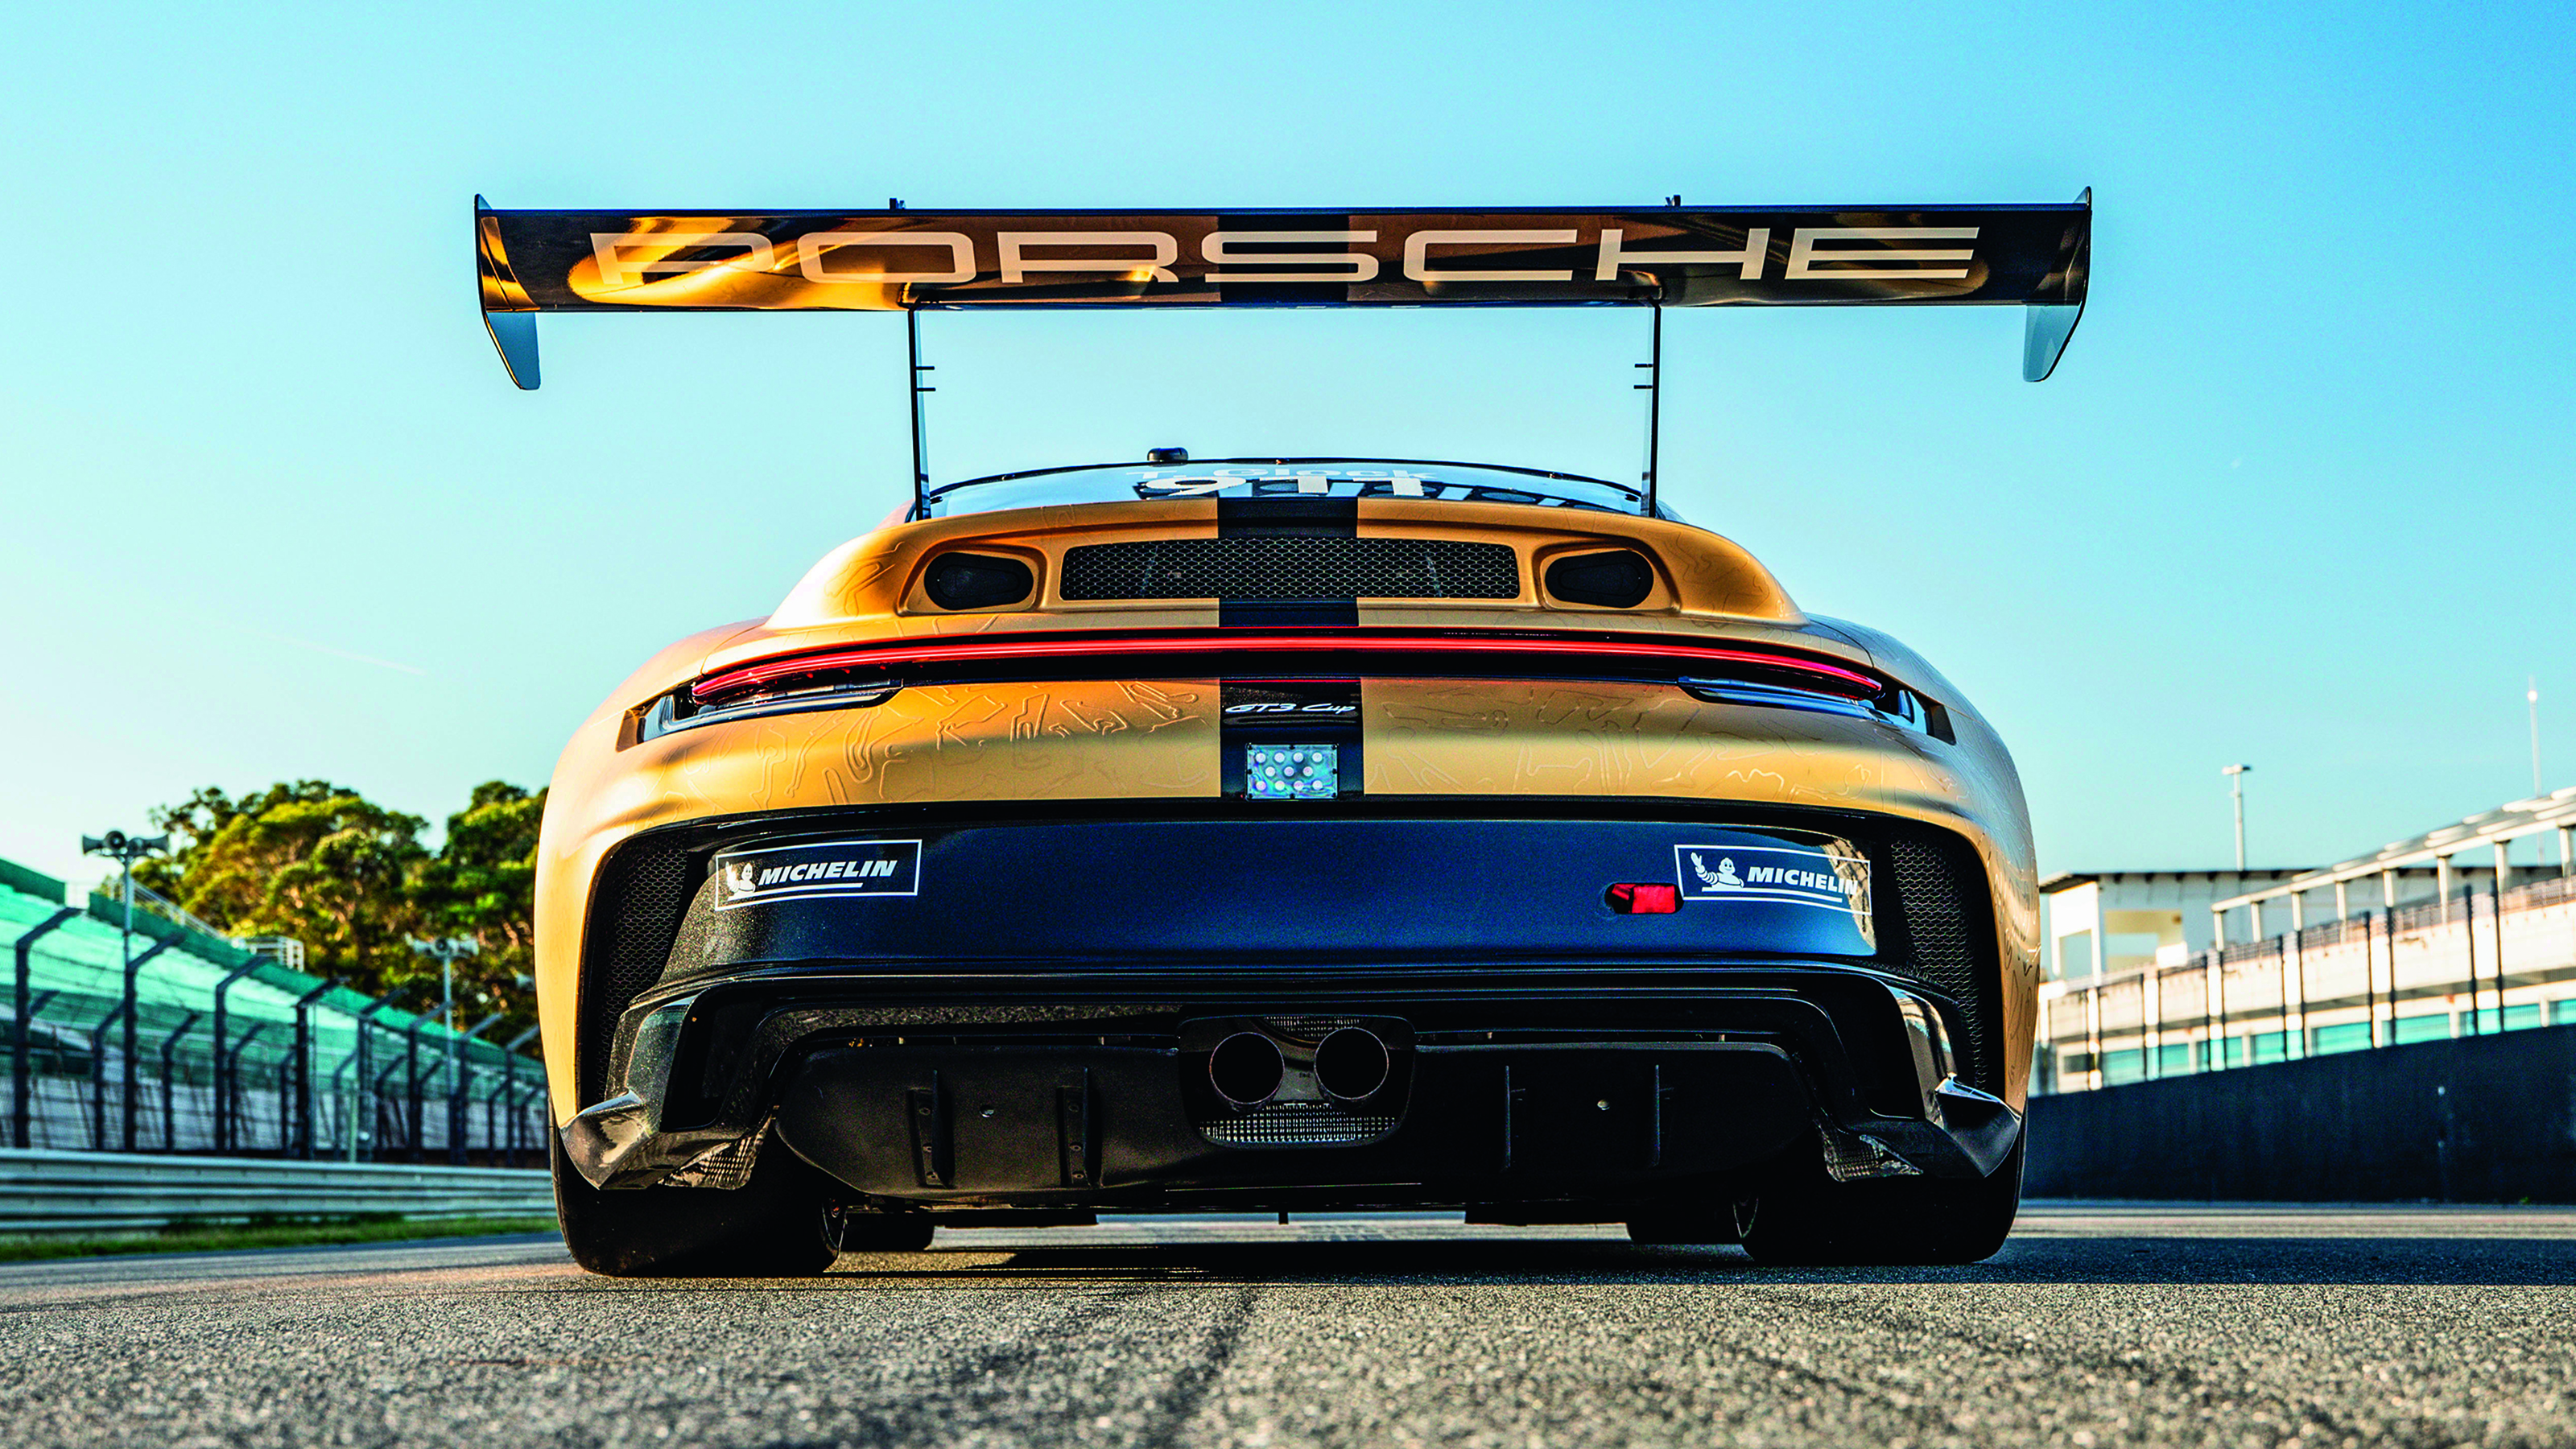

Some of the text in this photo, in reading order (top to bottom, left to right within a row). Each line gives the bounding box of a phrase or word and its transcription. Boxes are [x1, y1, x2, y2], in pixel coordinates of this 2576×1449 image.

[589, 226, 1980, 285] PORSCHE
[1146, 476, 1424, 497] 911
[1224, 703, 1356, 715] GT3 Cup
[758, 860, 898, 886] MICHELIN
[1747, 866, 1858, 895] MICHELIN
